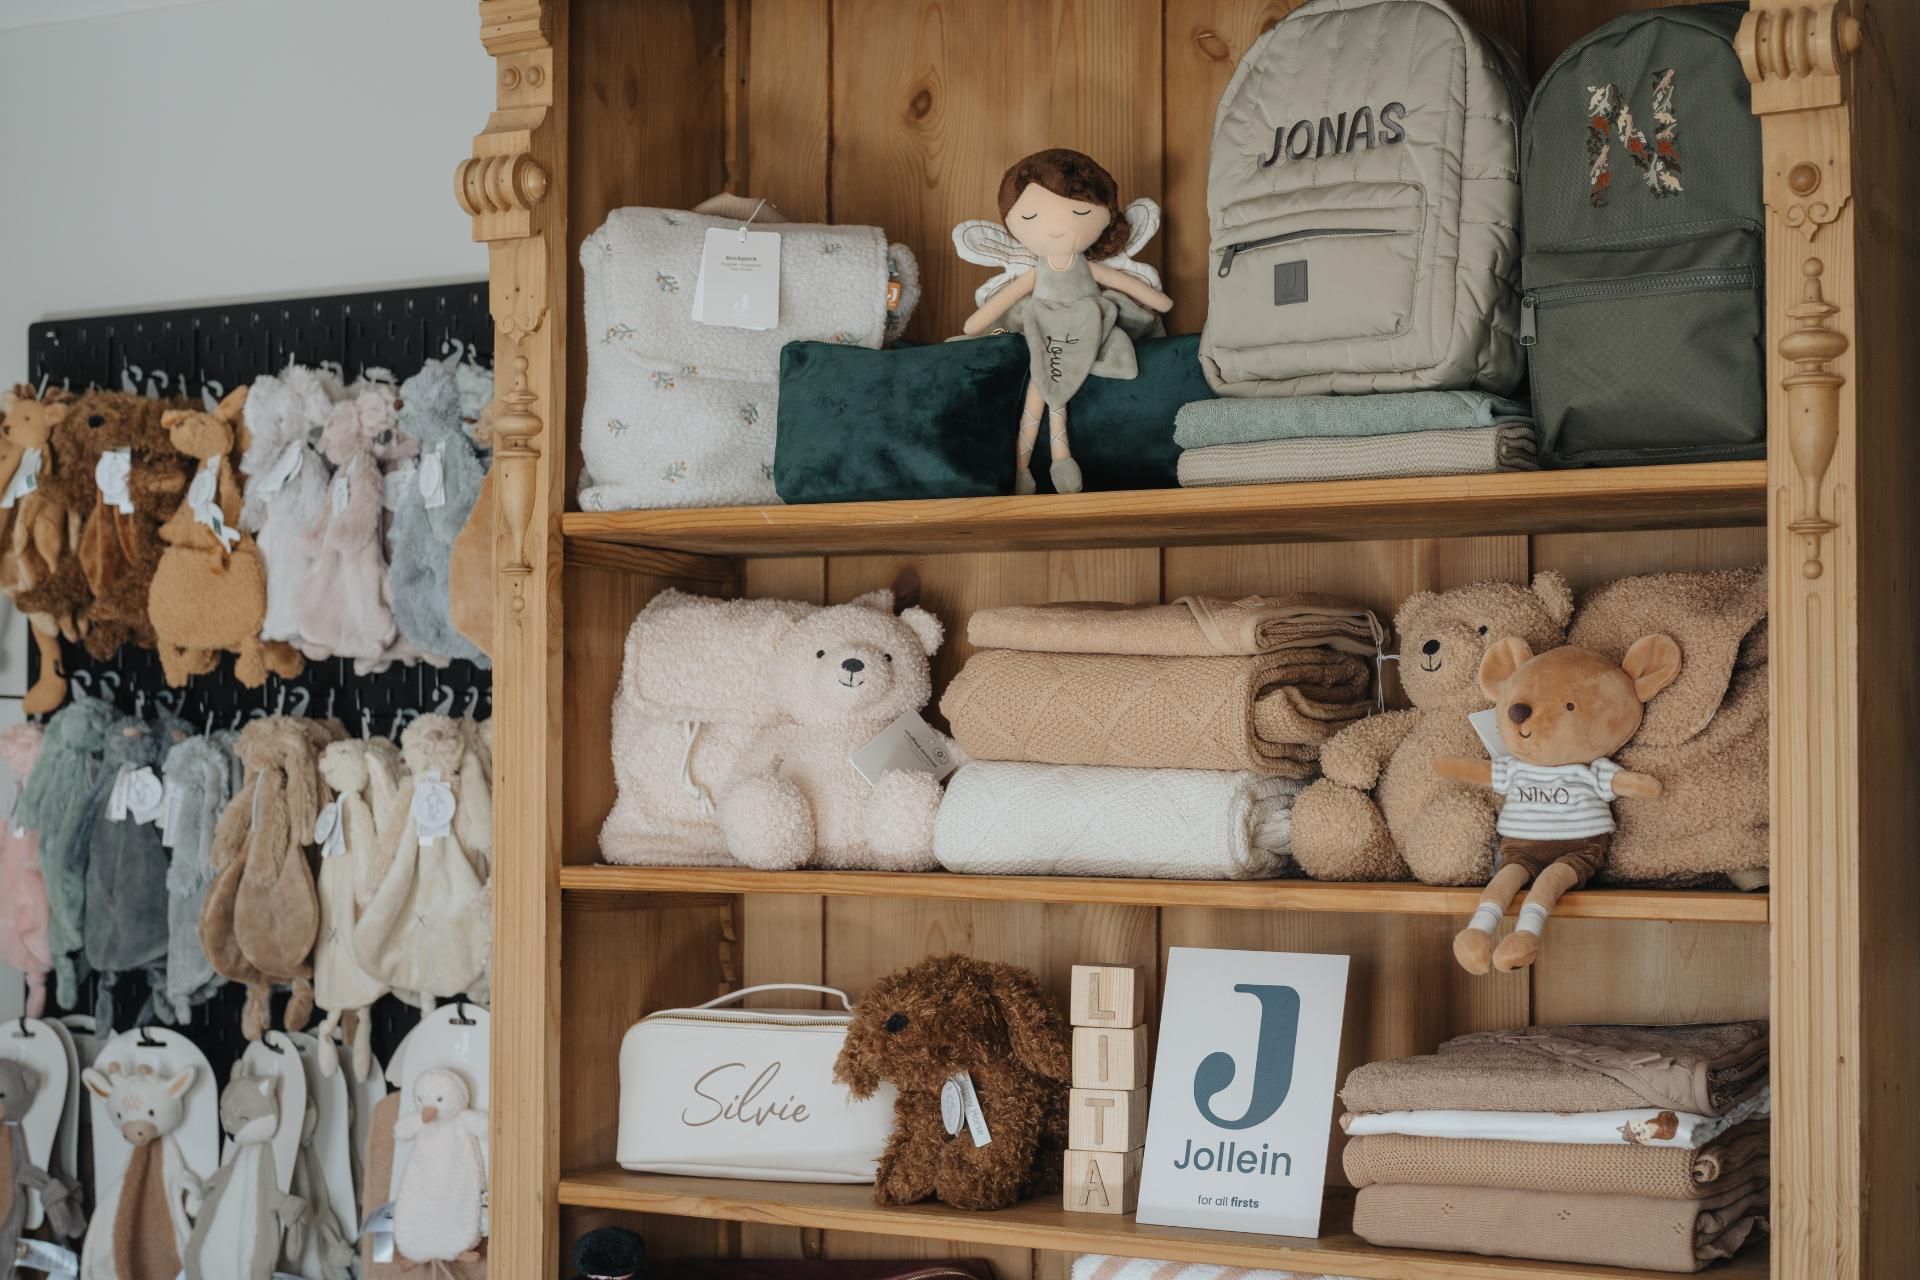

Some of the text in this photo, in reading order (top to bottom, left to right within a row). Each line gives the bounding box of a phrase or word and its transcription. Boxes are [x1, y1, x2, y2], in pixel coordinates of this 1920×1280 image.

[1257, 102, 1406, 168] JONAS
[1587, 68, 1684, 208] N
[1517, 786, 1570, 805] NINO
[1194, 983, 1300, 1130] J
[681, 1061, 810, 1127] Silvie
[1173, 1138, 1292, 1177] Jollein
[1197, 1194, 1260, 1209] for all firsts
